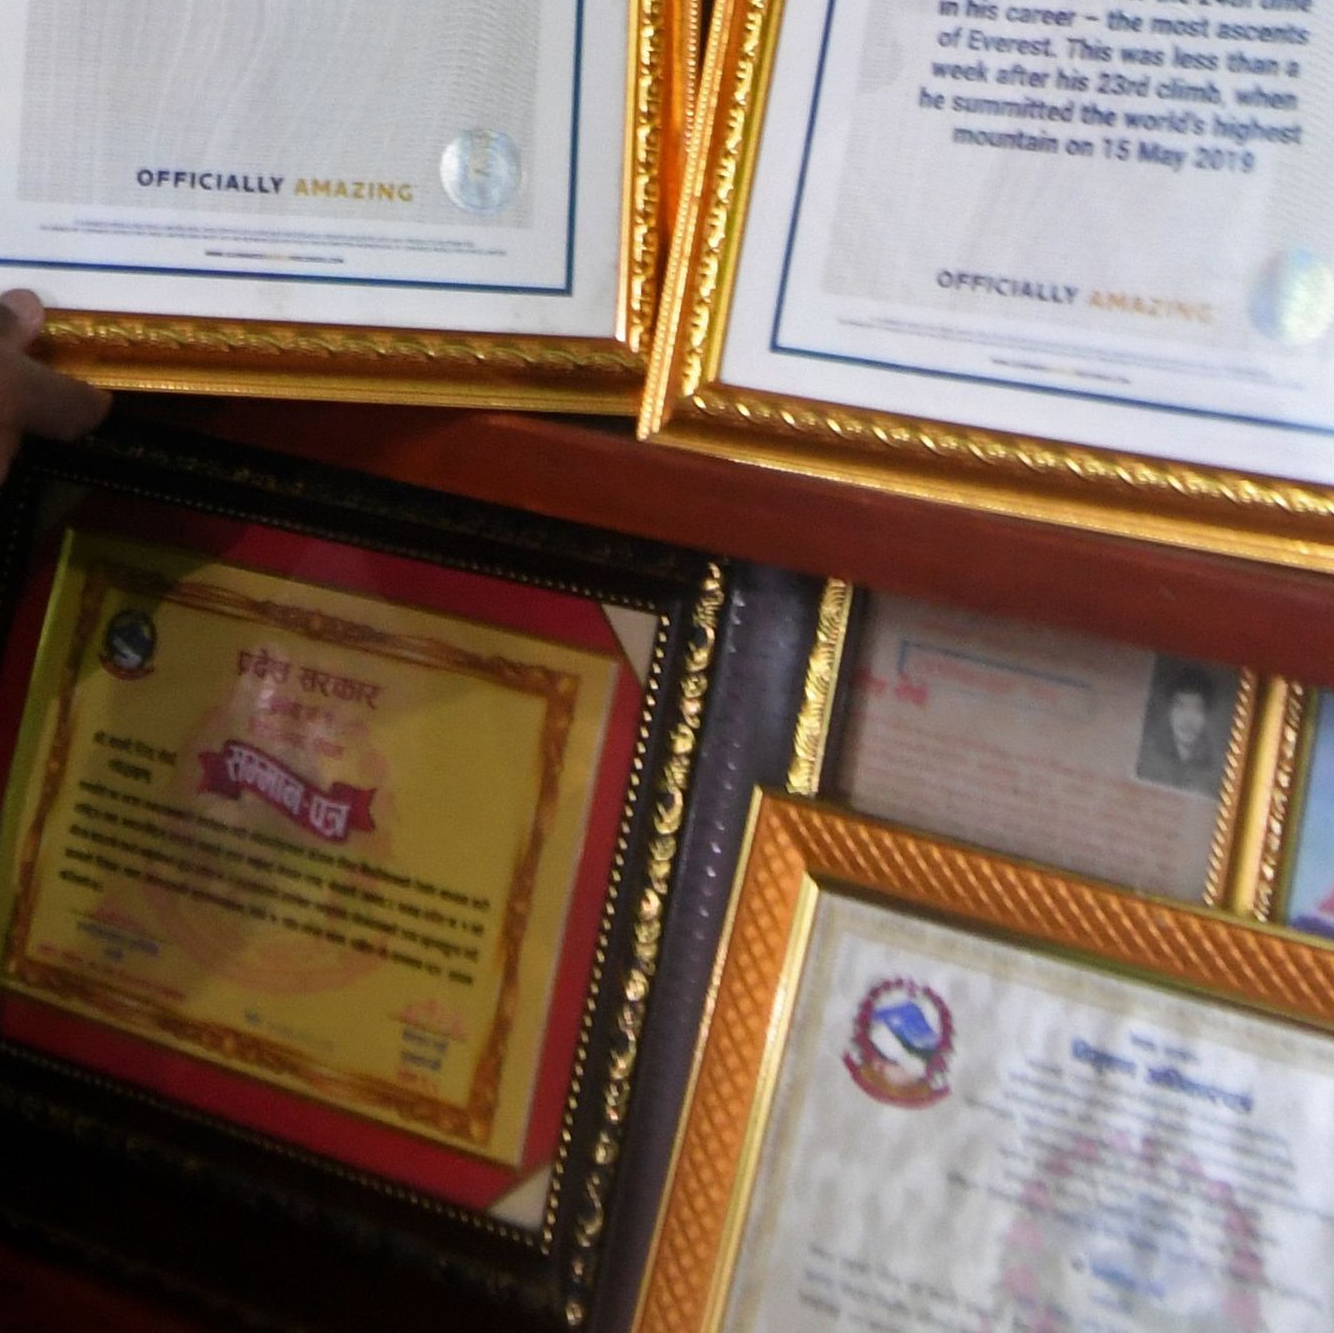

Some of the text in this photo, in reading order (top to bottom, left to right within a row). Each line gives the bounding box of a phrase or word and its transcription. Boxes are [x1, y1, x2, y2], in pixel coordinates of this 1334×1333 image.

[1005, 4, 1077, 27] career
[1107, 9, 1142, 33] the
[1151, 14, 1209, 38] most
[1217, 20, 1310, 45] ascents
[938, 27, 1299, 78] of Everest. This was less than a
[932, 59, 988, 82] week
[995, 64, 1049, 89] after
[1055, 68, 1089, 92] his
[1097, 72, 1149, 96] 23rd
[1235, 86, 1298, 109] when
[919, 86, 945, 109] he
[1081, 101, 1116, 127] the
[1212, 115, 1302, 145] highest
[953, 124, 1254, 174] mountain on 15 May 2019
[137, 168, 413, 202] OFFICIALLY AMAZING
[937, 269, 1078, 305] OFFICIALLY
